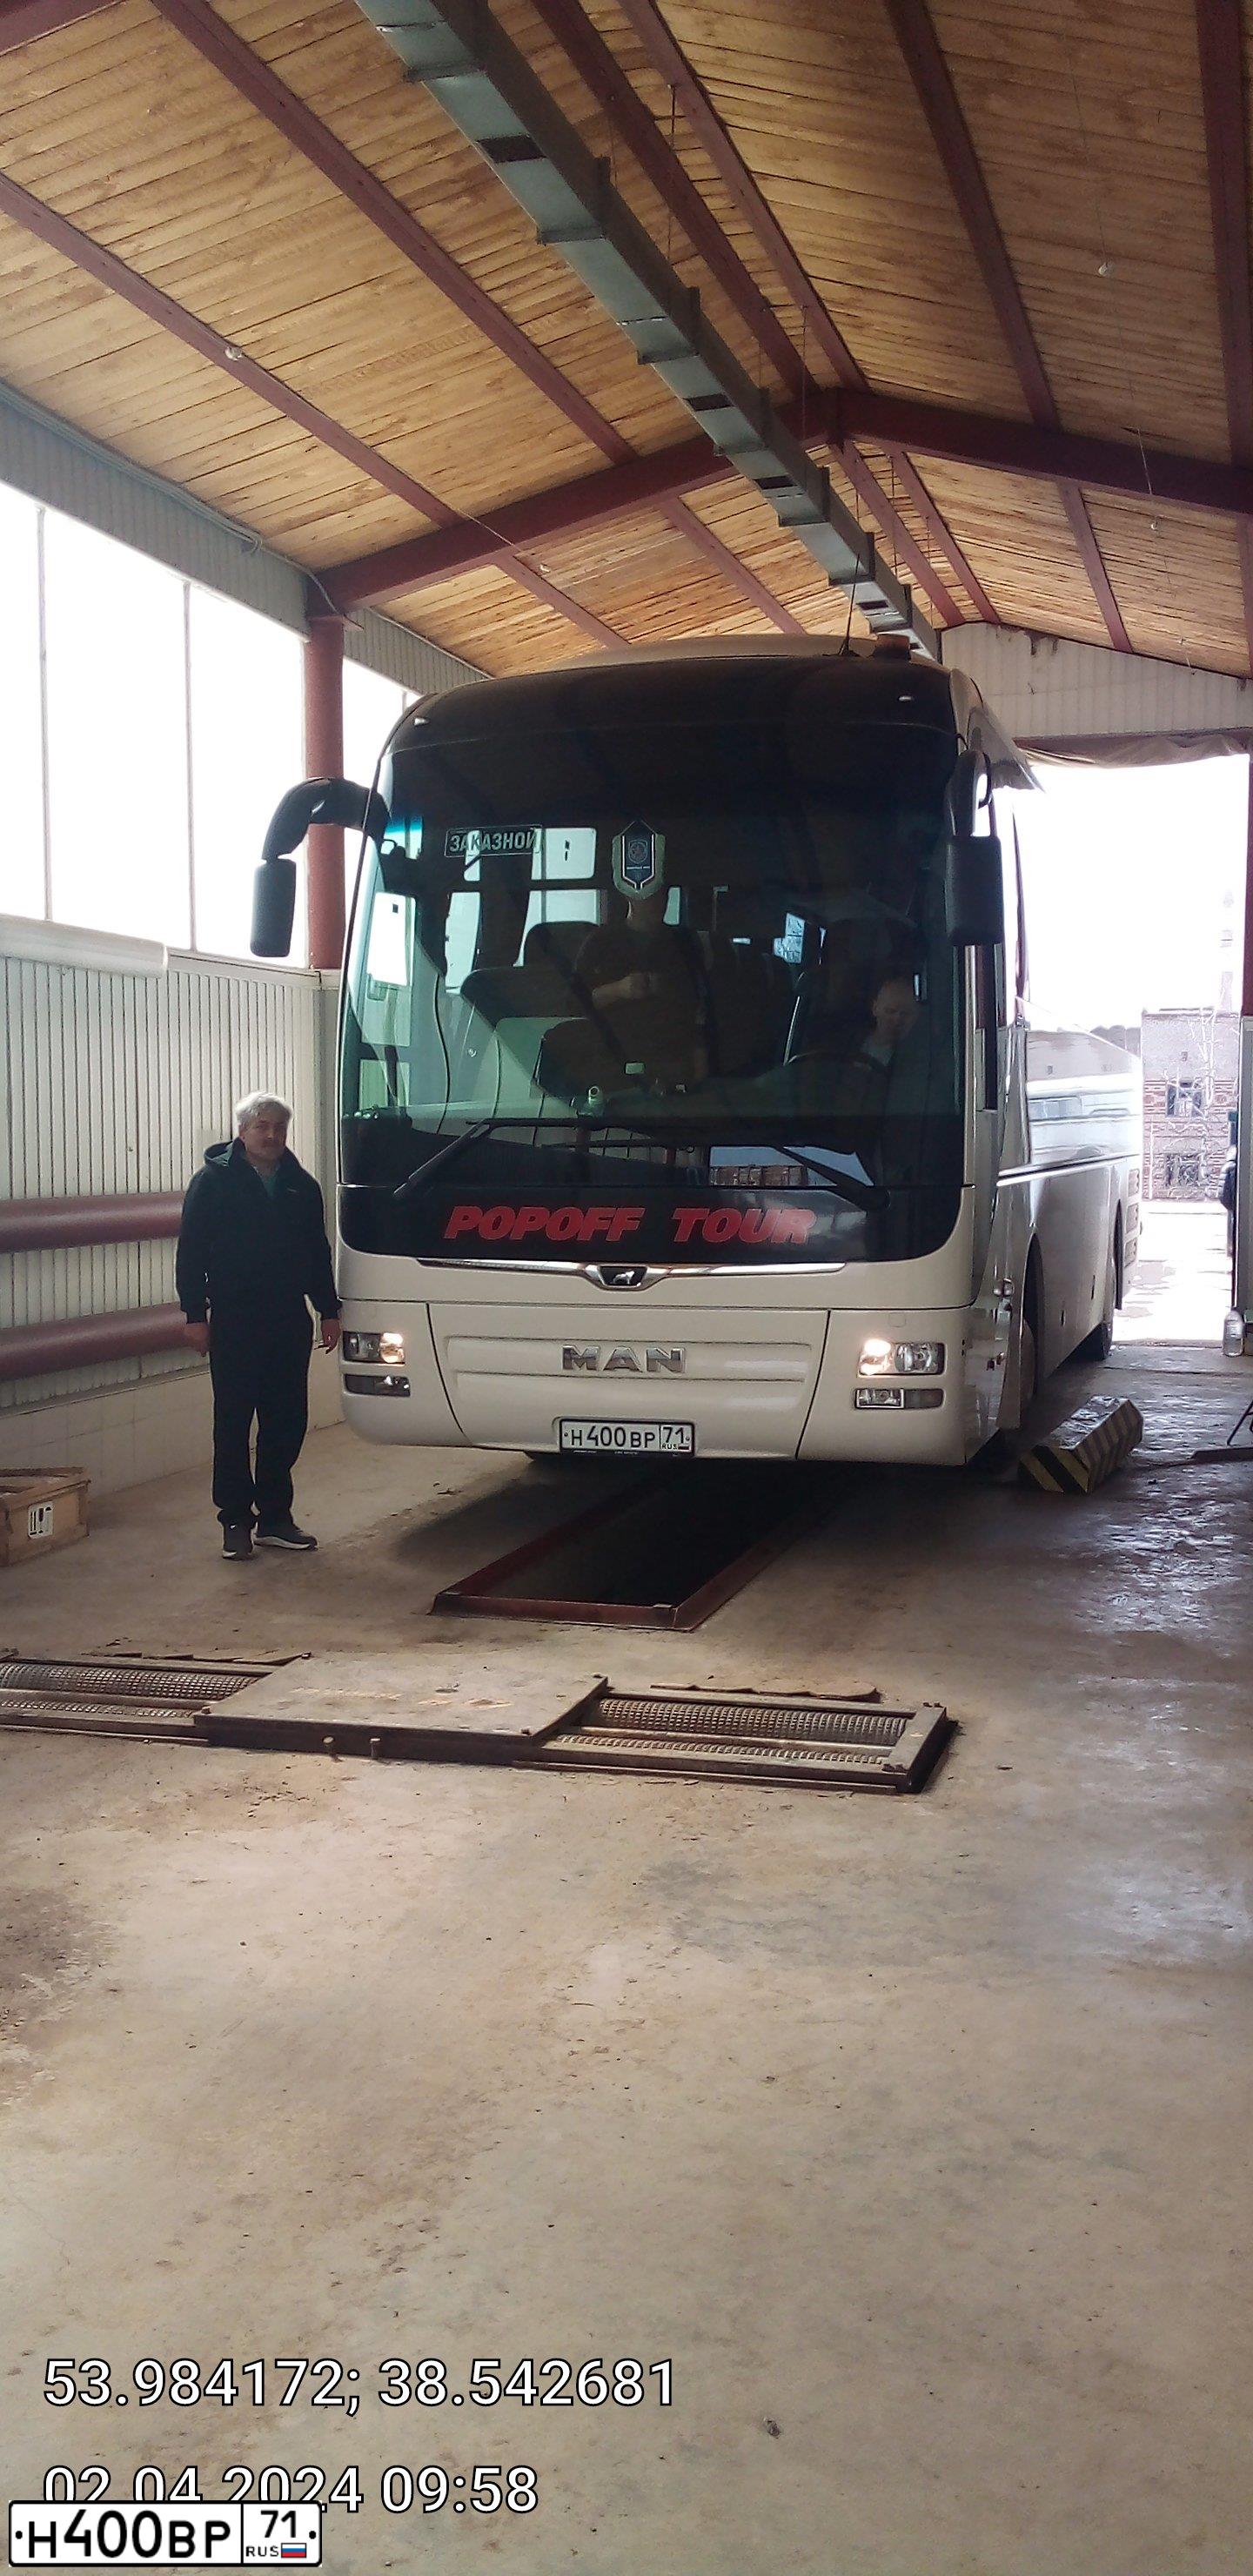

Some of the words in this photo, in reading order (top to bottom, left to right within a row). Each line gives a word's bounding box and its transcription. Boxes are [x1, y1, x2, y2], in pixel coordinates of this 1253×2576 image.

[444, 1205, 645, 1241] POPOFF
[673, 1207, 816, 1244] TOUR
[562, 1345, 686, 1372] MAN
